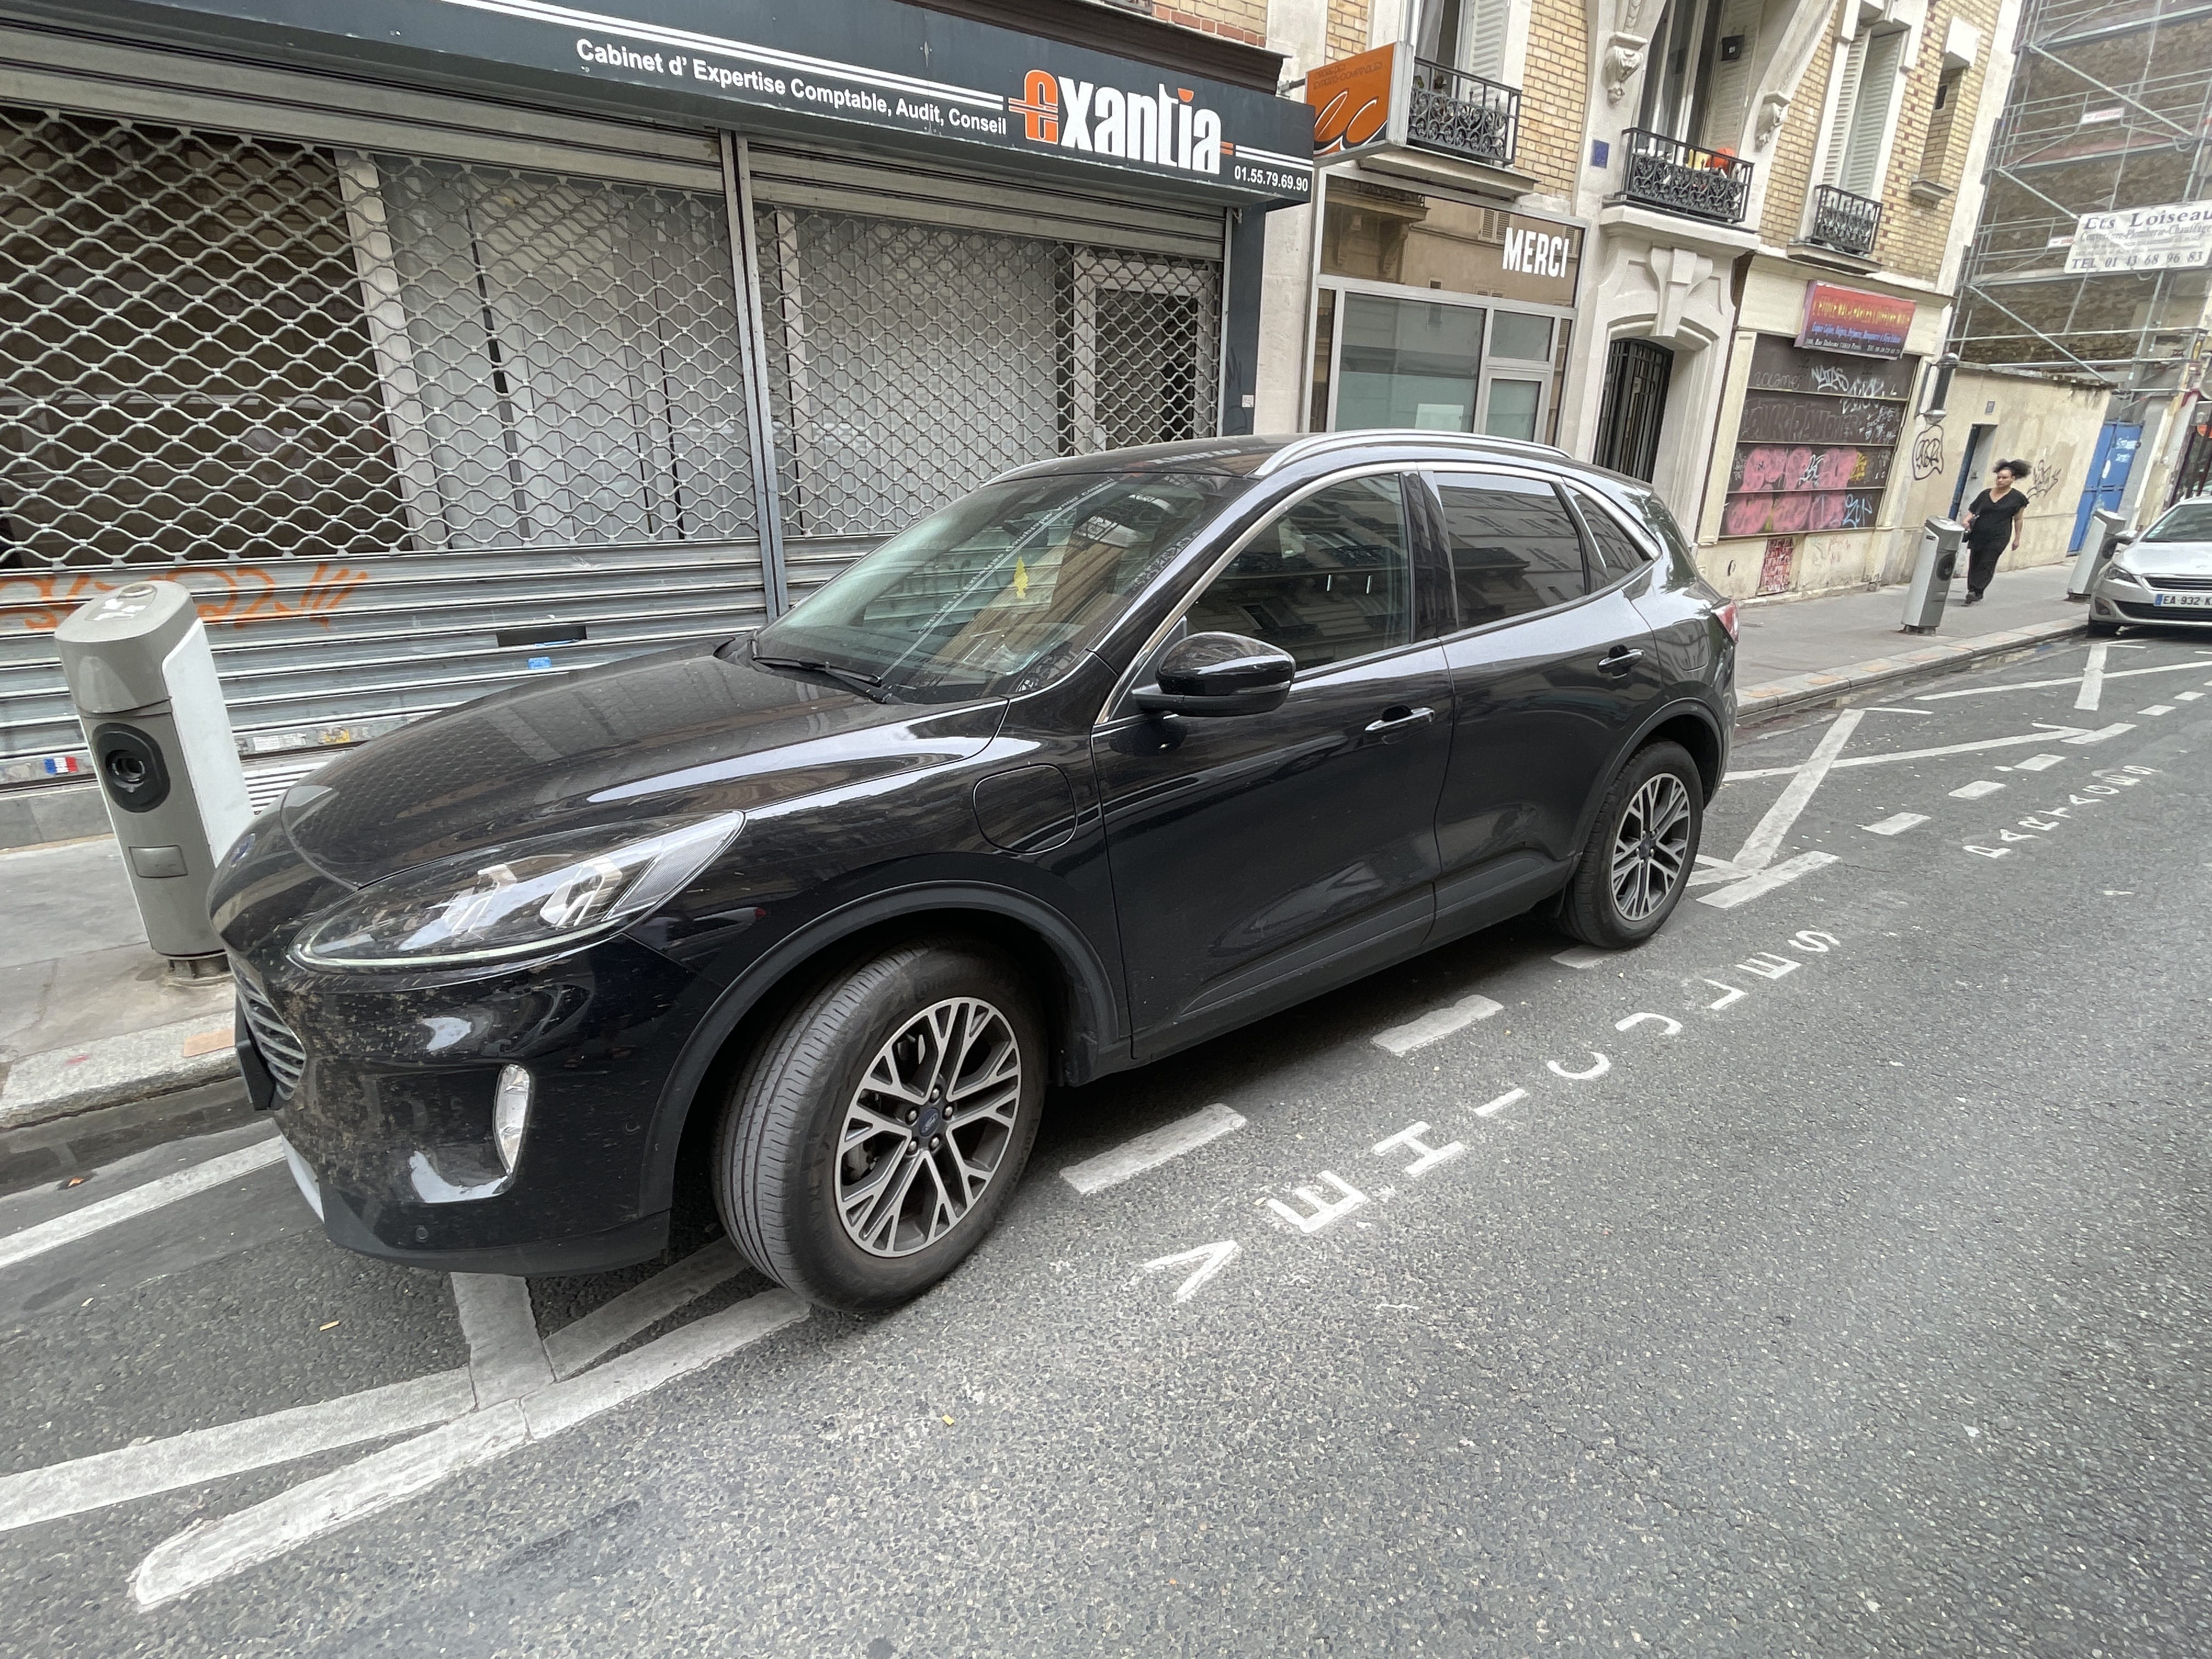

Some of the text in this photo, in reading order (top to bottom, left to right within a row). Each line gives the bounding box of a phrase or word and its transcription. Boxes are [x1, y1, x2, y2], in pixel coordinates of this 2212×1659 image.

[575, 38, 663, 75] Cabinet
[693, 58, 786, 96] Expertise
[791, 77, 892, 117] Comptable,
[895, 97, 945, 126] Audit,
[949, 109, 1007, 136] Conseil
[1234, 165, 1309, 193] 01.55.79.69.90
[2130, 210, 2212, 227] Loiseau
[1502, 227, 1571, 279] MERCI
[2071, 258, 2097, 269] TEL
[2104, 256, 2119, 268] 01
[2143, 253, 2159, 264] 68
[2166, 252, 2181, 263] 96
[2187, 251, 2203, 262] 83
